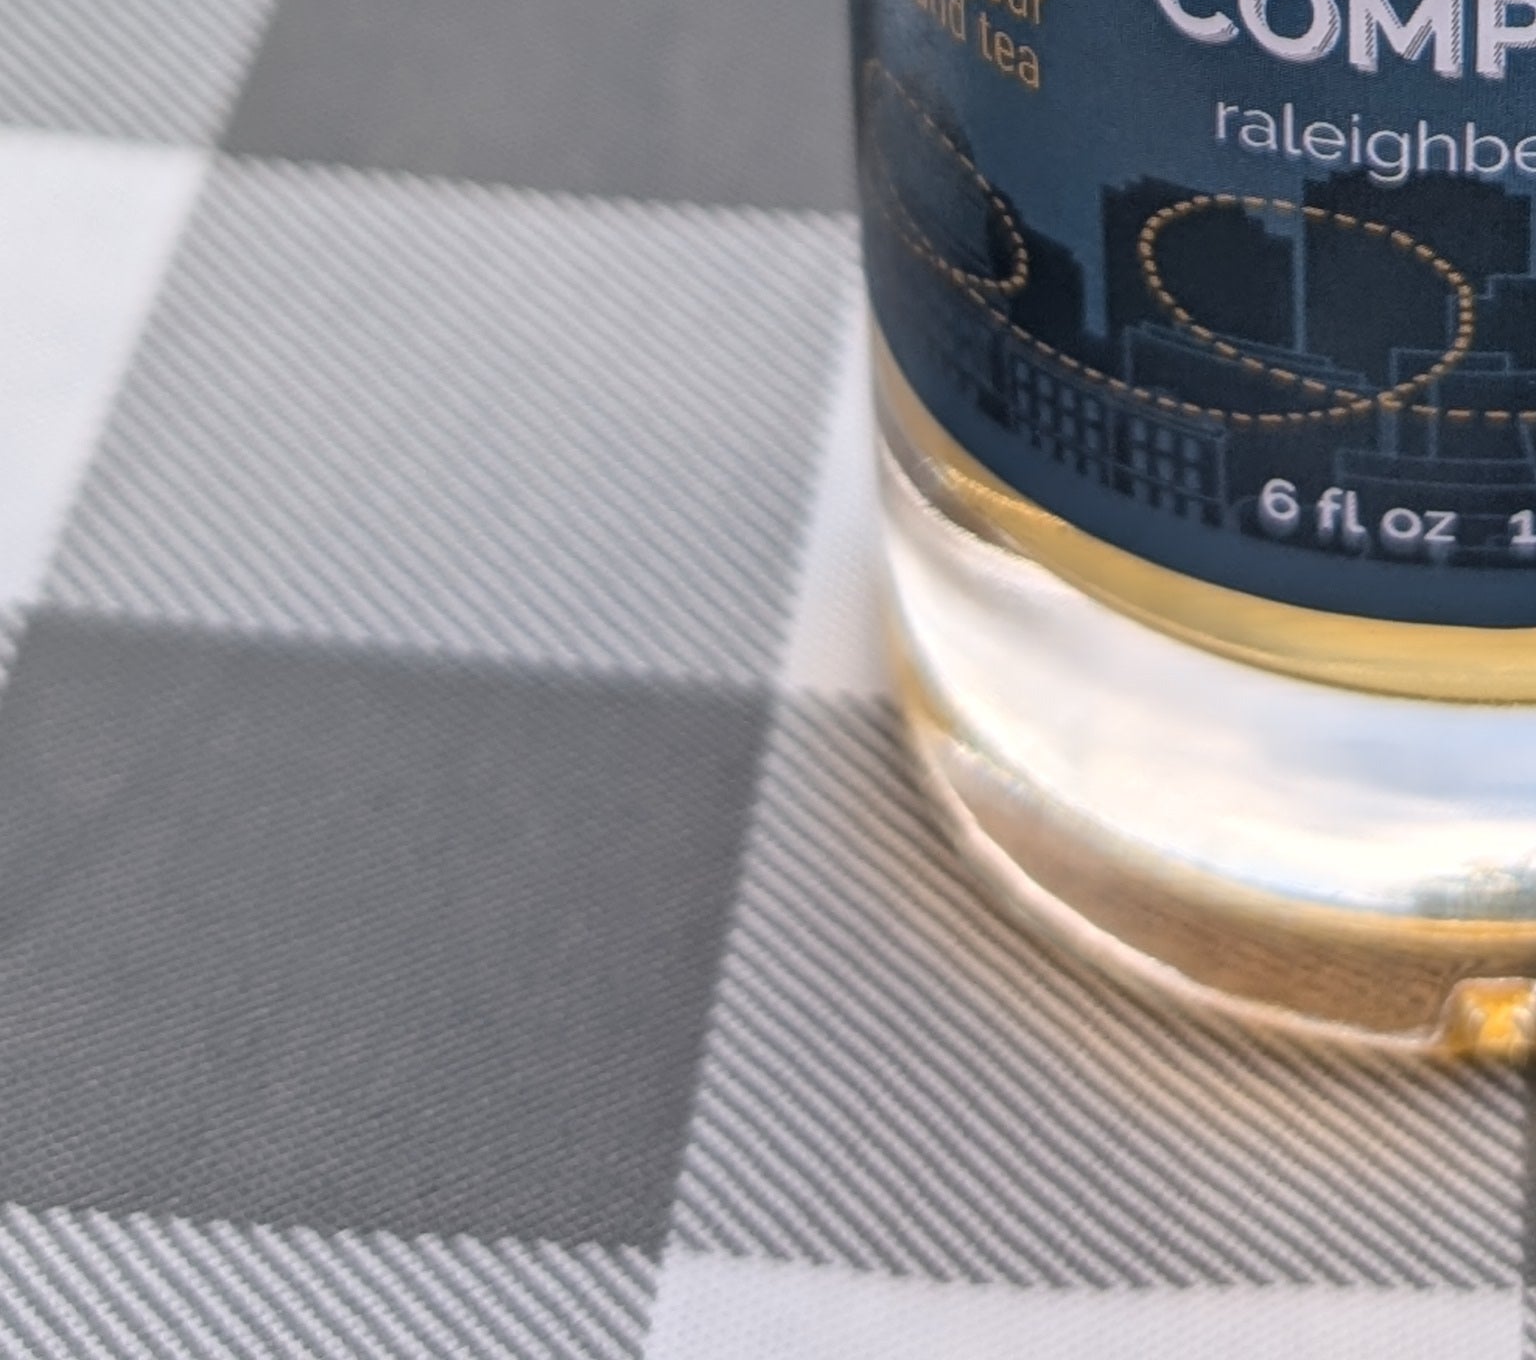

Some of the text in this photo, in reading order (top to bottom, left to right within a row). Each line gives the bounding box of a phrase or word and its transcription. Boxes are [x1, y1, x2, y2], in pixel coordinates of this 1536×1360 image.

[979, 10, 1041, 89] tea
[1259, 477, 1300, 525] 6
[1316, 485, 1367, 537] fl
[1381, 506, 1458, 547] oz
